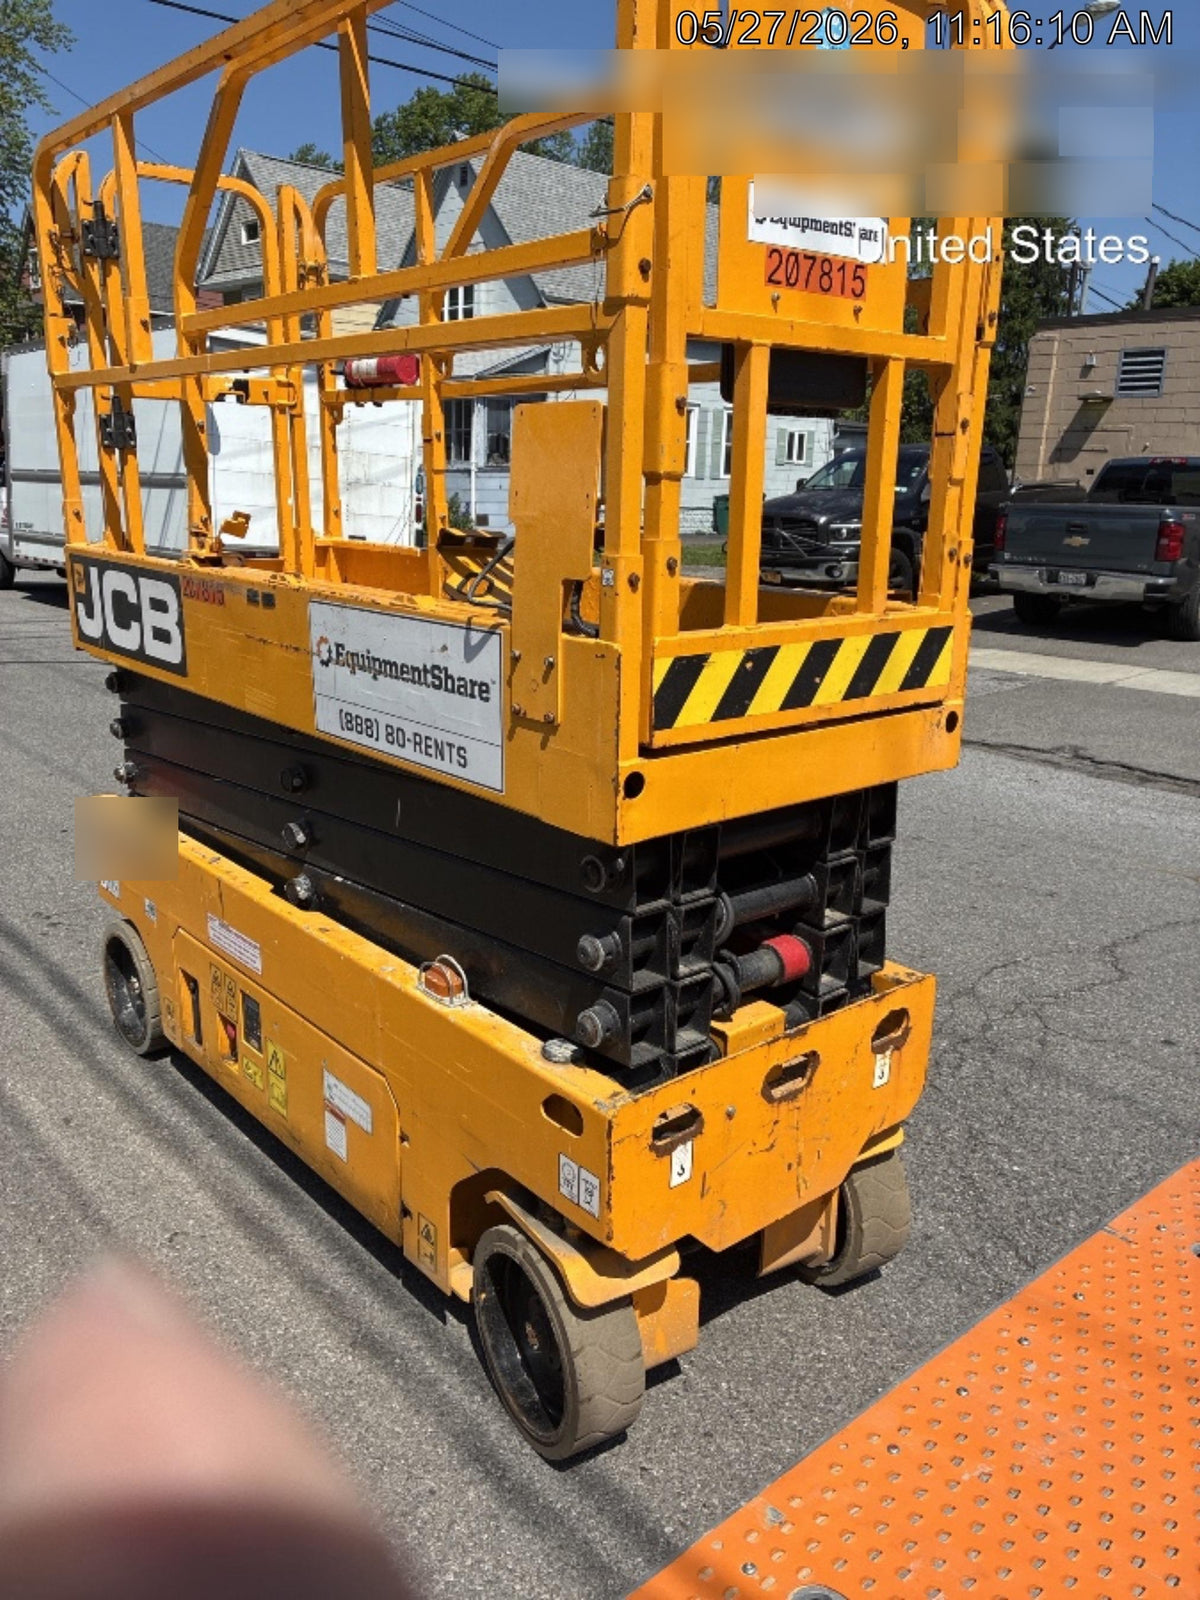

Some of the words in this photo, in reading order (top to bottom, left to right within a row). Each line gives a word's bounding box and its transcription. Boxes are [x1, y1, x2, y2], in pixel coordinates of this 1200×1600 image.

[767, 249, 865, 298] 207815
[77, 566, 183, 664] JCB
[334, 642, 491, 703] EquipmentShare
[339, 708, 379, 742] (888)
[385, 723, 468, 769] 80-RENTS
